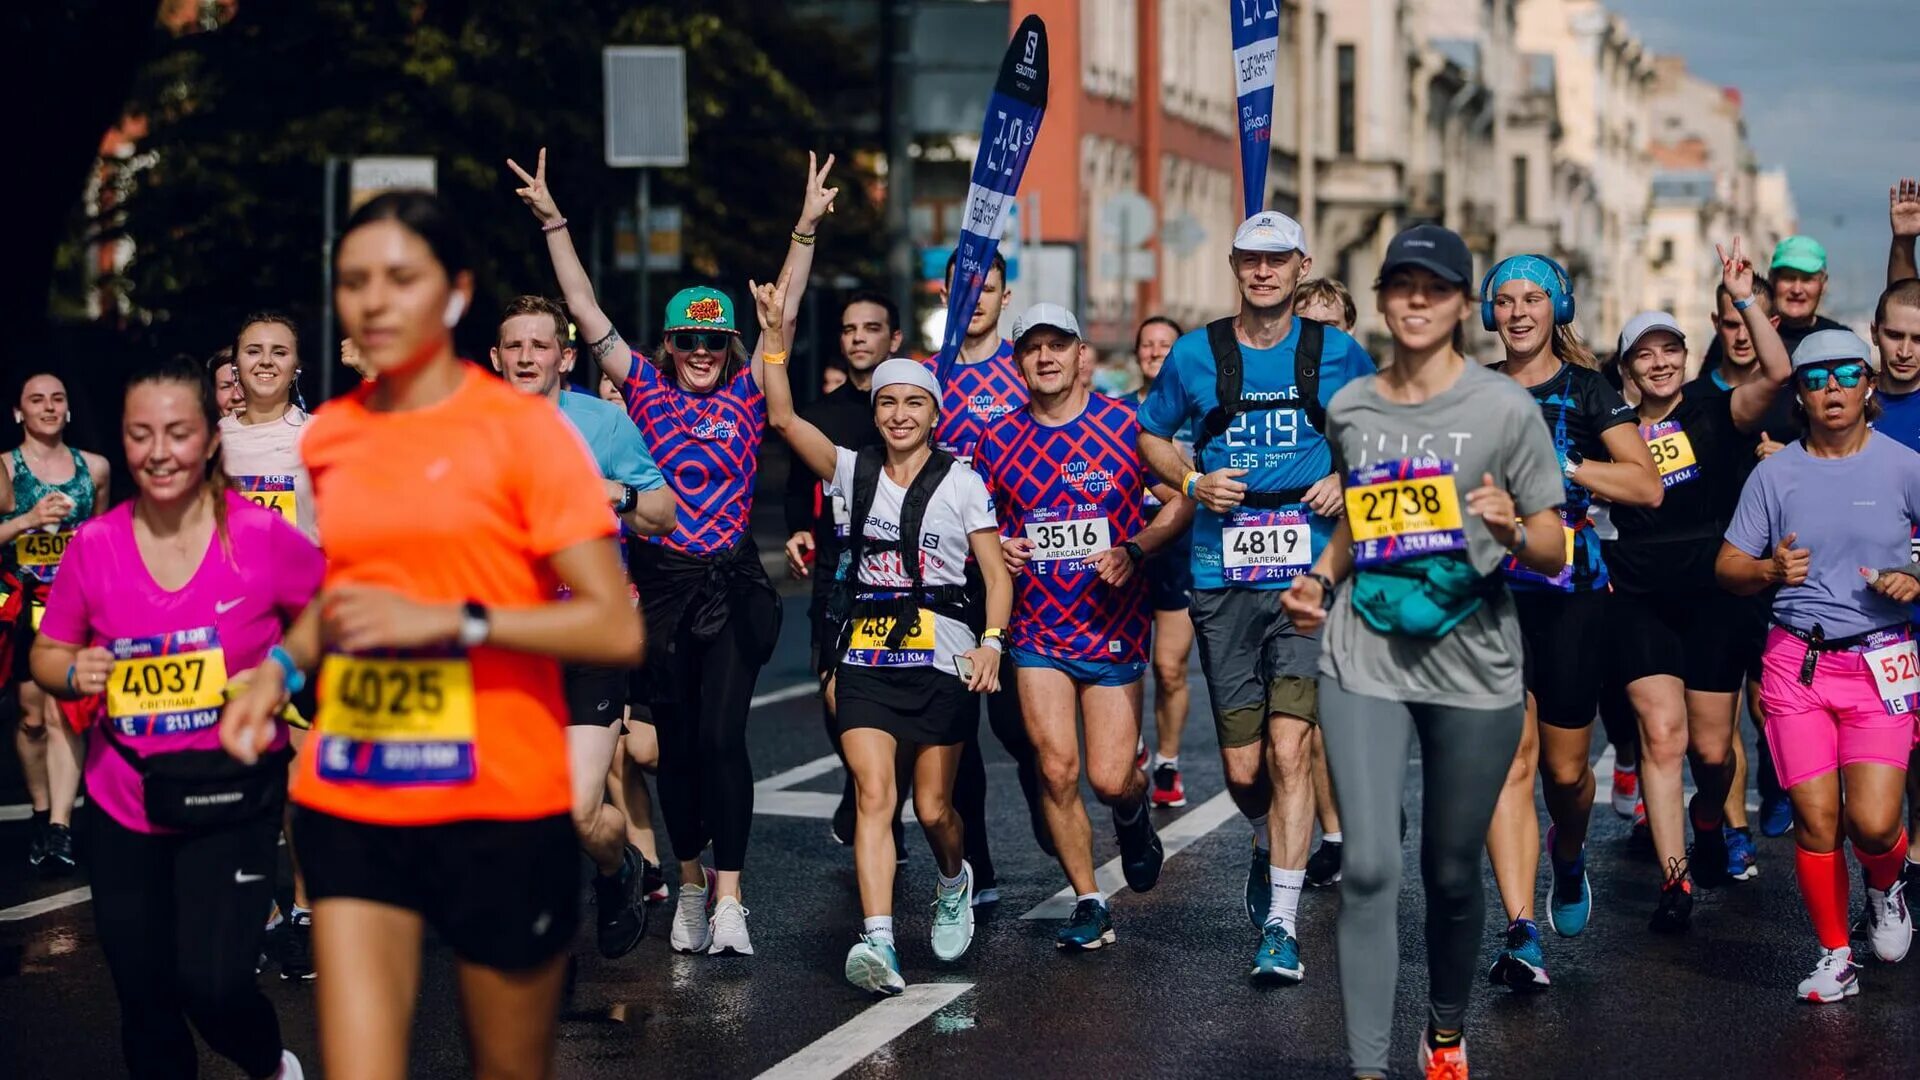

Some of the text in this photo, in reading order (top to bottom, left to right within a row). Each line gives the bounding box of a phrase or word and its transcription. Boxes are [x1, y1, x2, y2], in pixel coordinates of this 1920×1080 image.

[968, 395, 995, 404] ПОЛУ
[1226, 409, 1298, 447] 2:19
[1061, 461, 1088, 474] ПОЛУ
[1230, 453, 1258, 468] 6:35
[264, 475, 285, 484] 8.08
[1061, 470, 1114, 485] МАРАФОН
[1077, 503, 1097, 512] 8.08
[1361, 485, 1440, 522] 2738
[1037, 523, 1097, 549] 3516
[1233, 529, 1298, 555] 4819
[1046, 548, 1092, 558] АЛЕКСАНДР
[1248, 555, 1287, 564] ВАЛЕРИЙ
[1038, 561, 1047, 575] E
[1233, 568, 1242, 580] E
[1266, 568, 1284, 579] 21,1
[887, 652, 904, 663] 21,1
[122, 657, 205, 697] 4037
[338, 667, 444, 717] 4025
[1893, 698, 1904, 712] E
[121, 716, 136, 735] E
